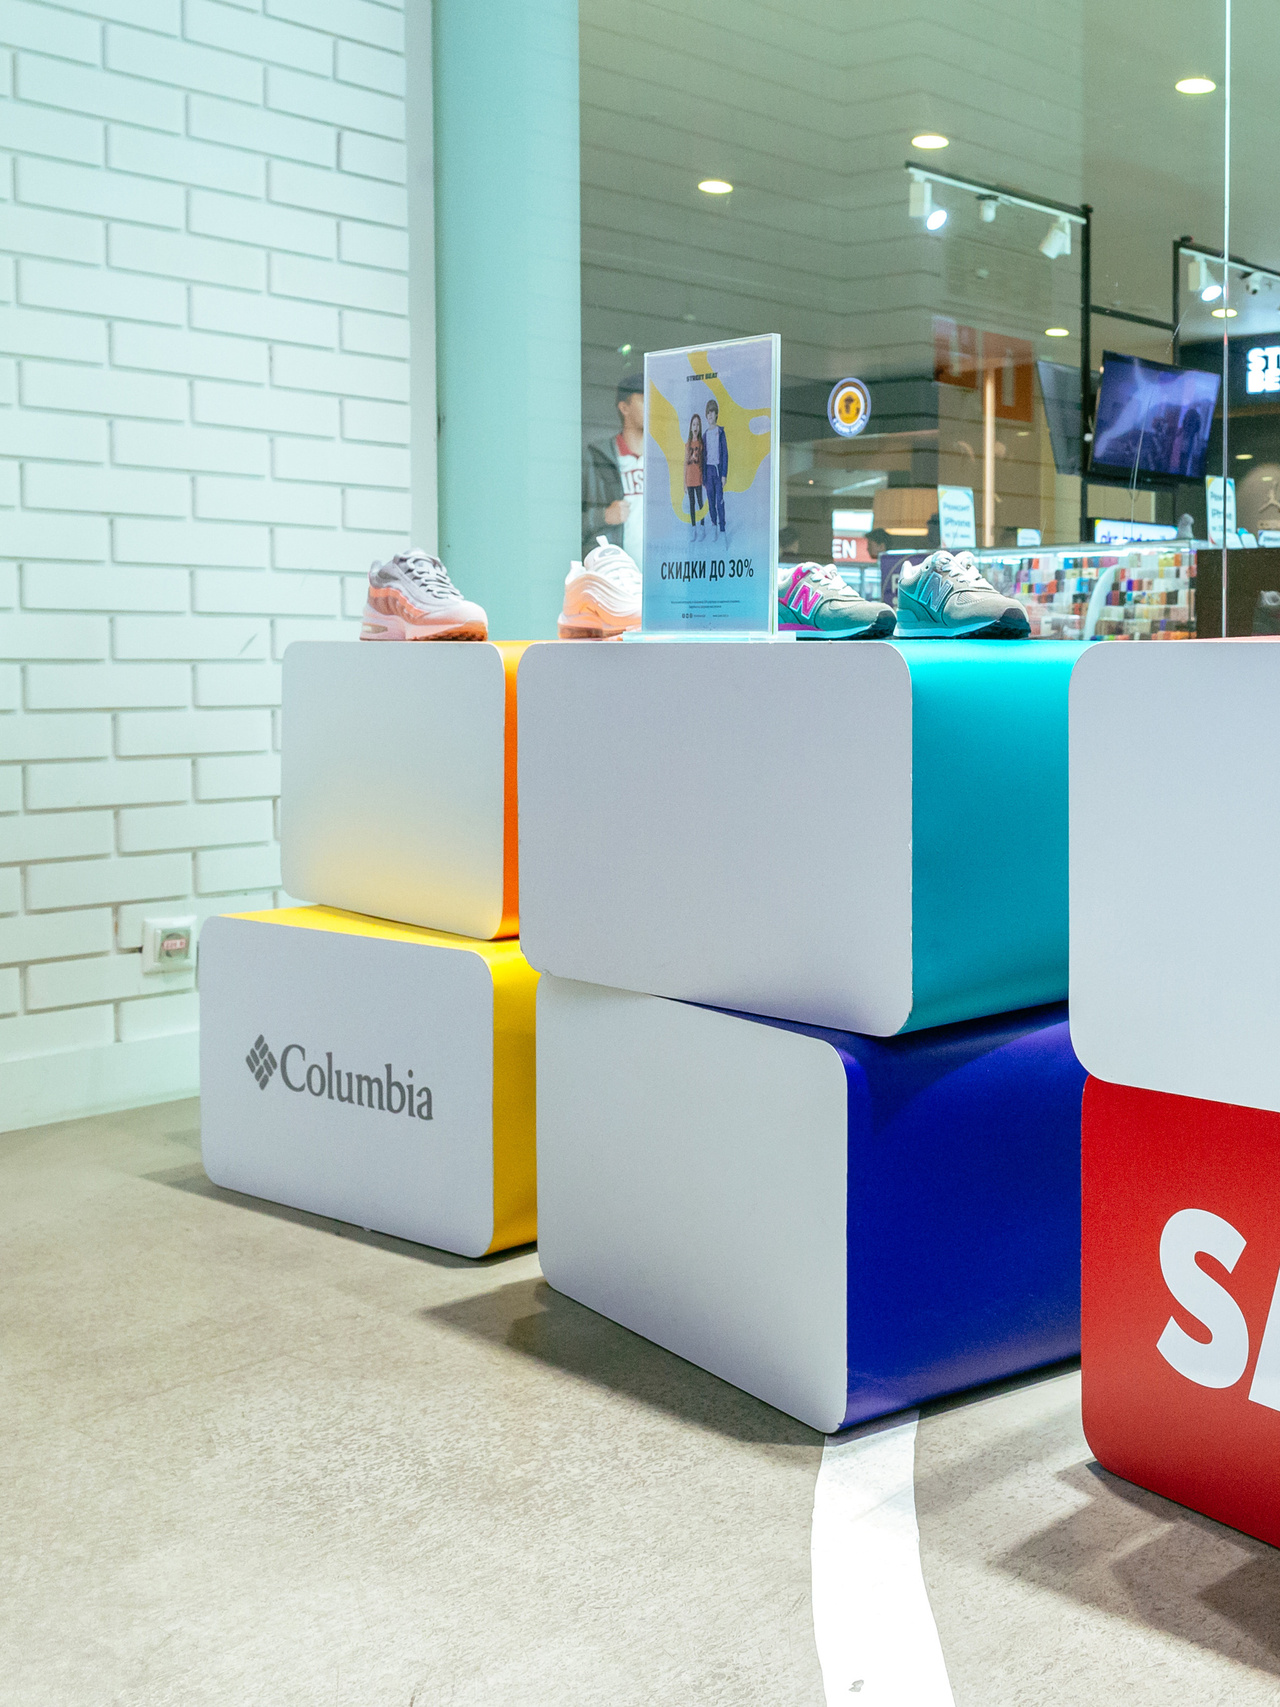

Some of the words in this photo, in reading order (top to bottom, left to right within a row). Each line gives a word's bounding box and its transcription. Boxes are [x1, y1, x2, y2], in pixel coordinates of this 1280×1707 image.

[661, 560, 706, 582] СКИДКИ
[709, 559, 726, 581] ДО
[728, 558, 754, 578] 30%
[280, 1044, 434, 1120] Columbia
